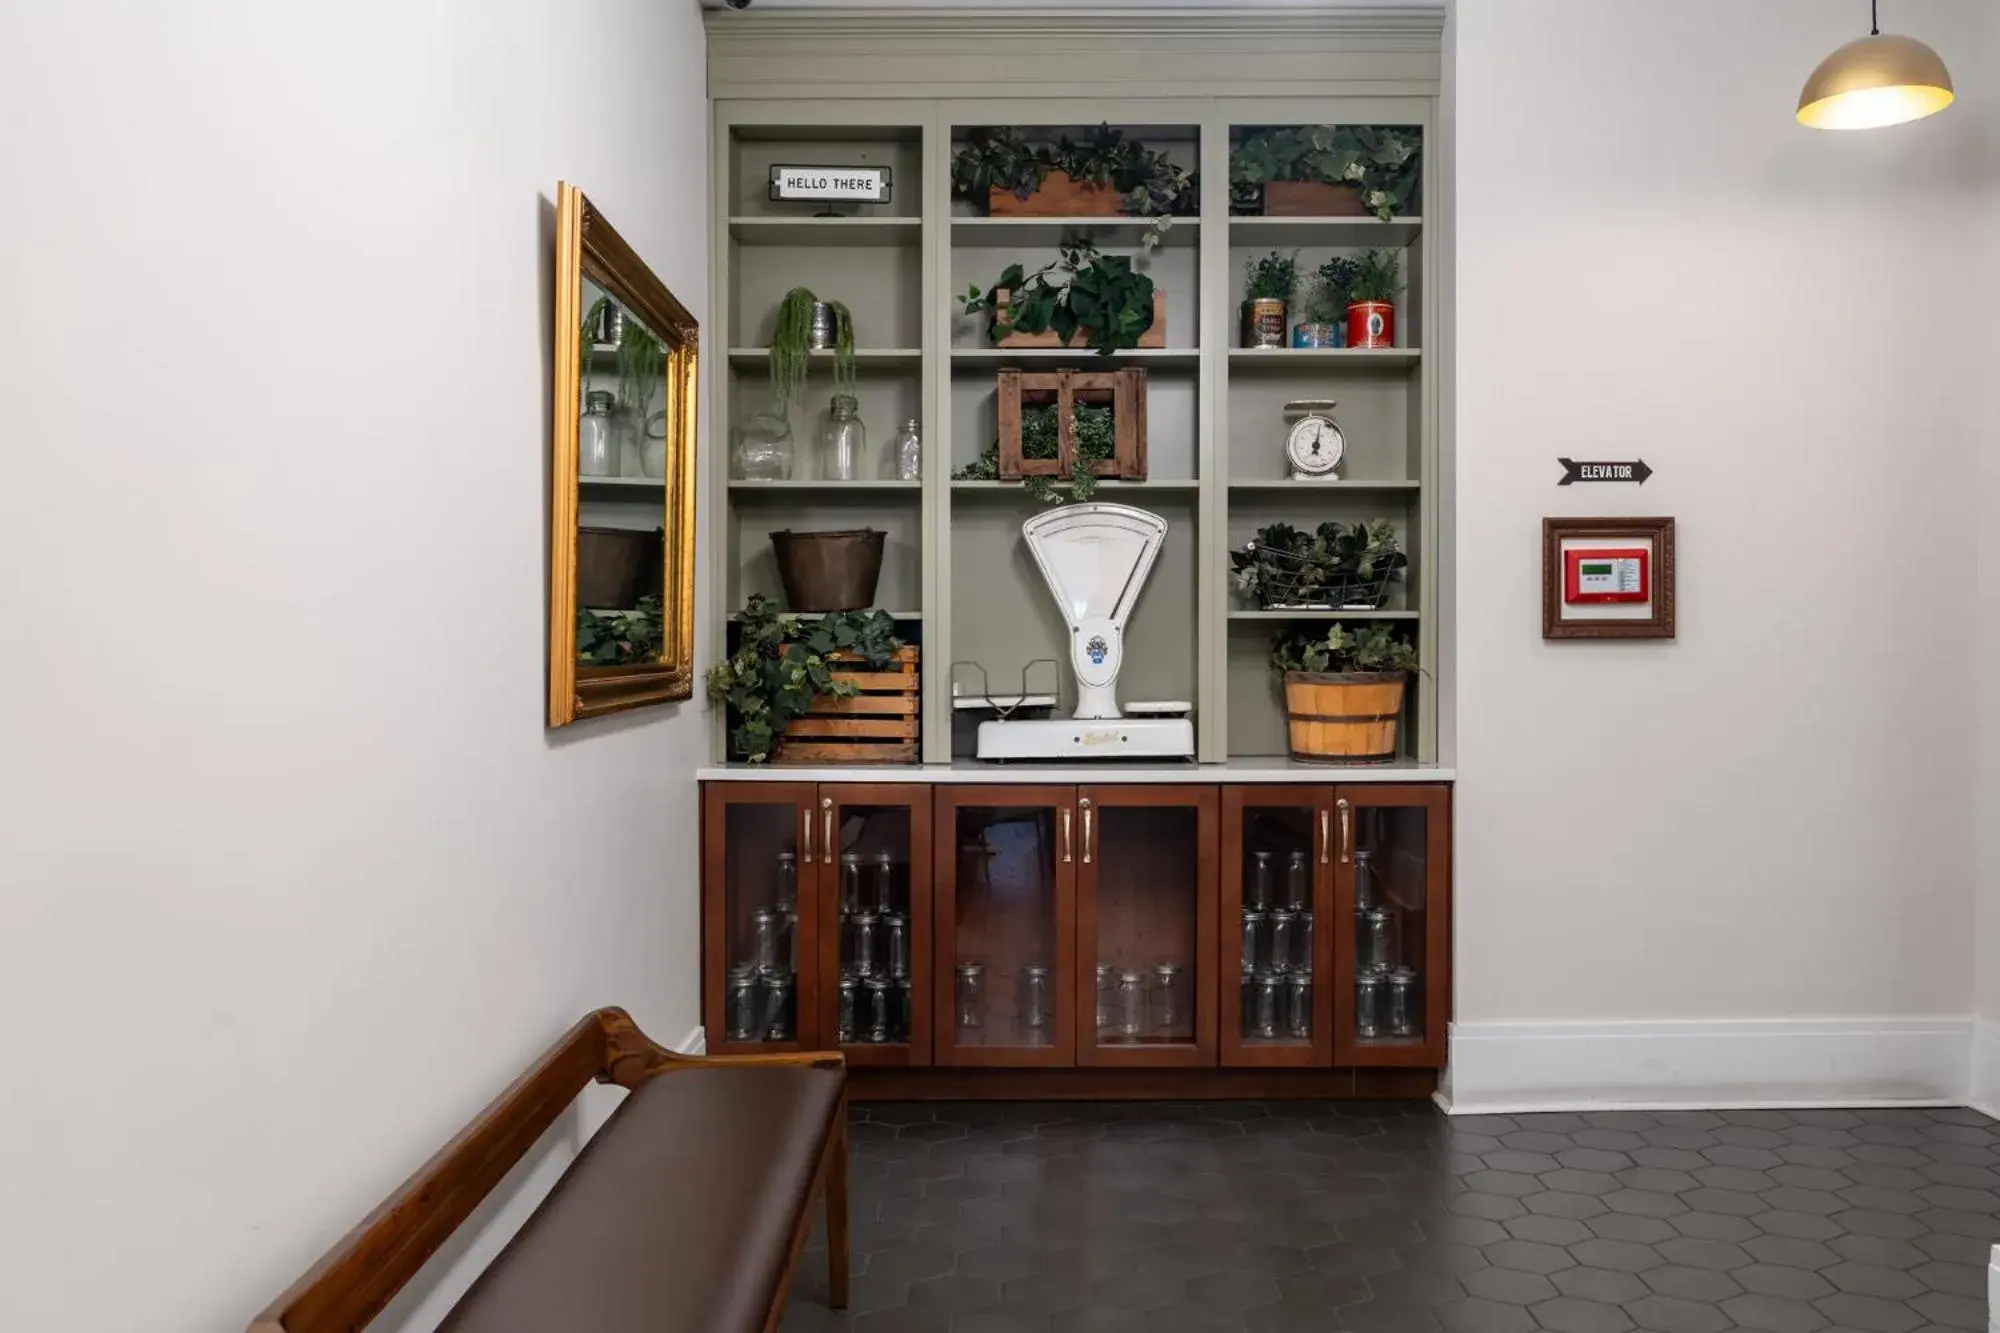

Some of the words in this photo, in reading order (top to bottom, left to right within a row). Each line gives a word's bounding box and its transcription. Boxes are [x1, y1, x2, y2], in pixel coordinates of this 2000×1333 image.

[787, 177, 827, 189] HELLO
[833, 178, 873, 190] THERE
[1581, 465, 1632, 478] ELEVATOR
